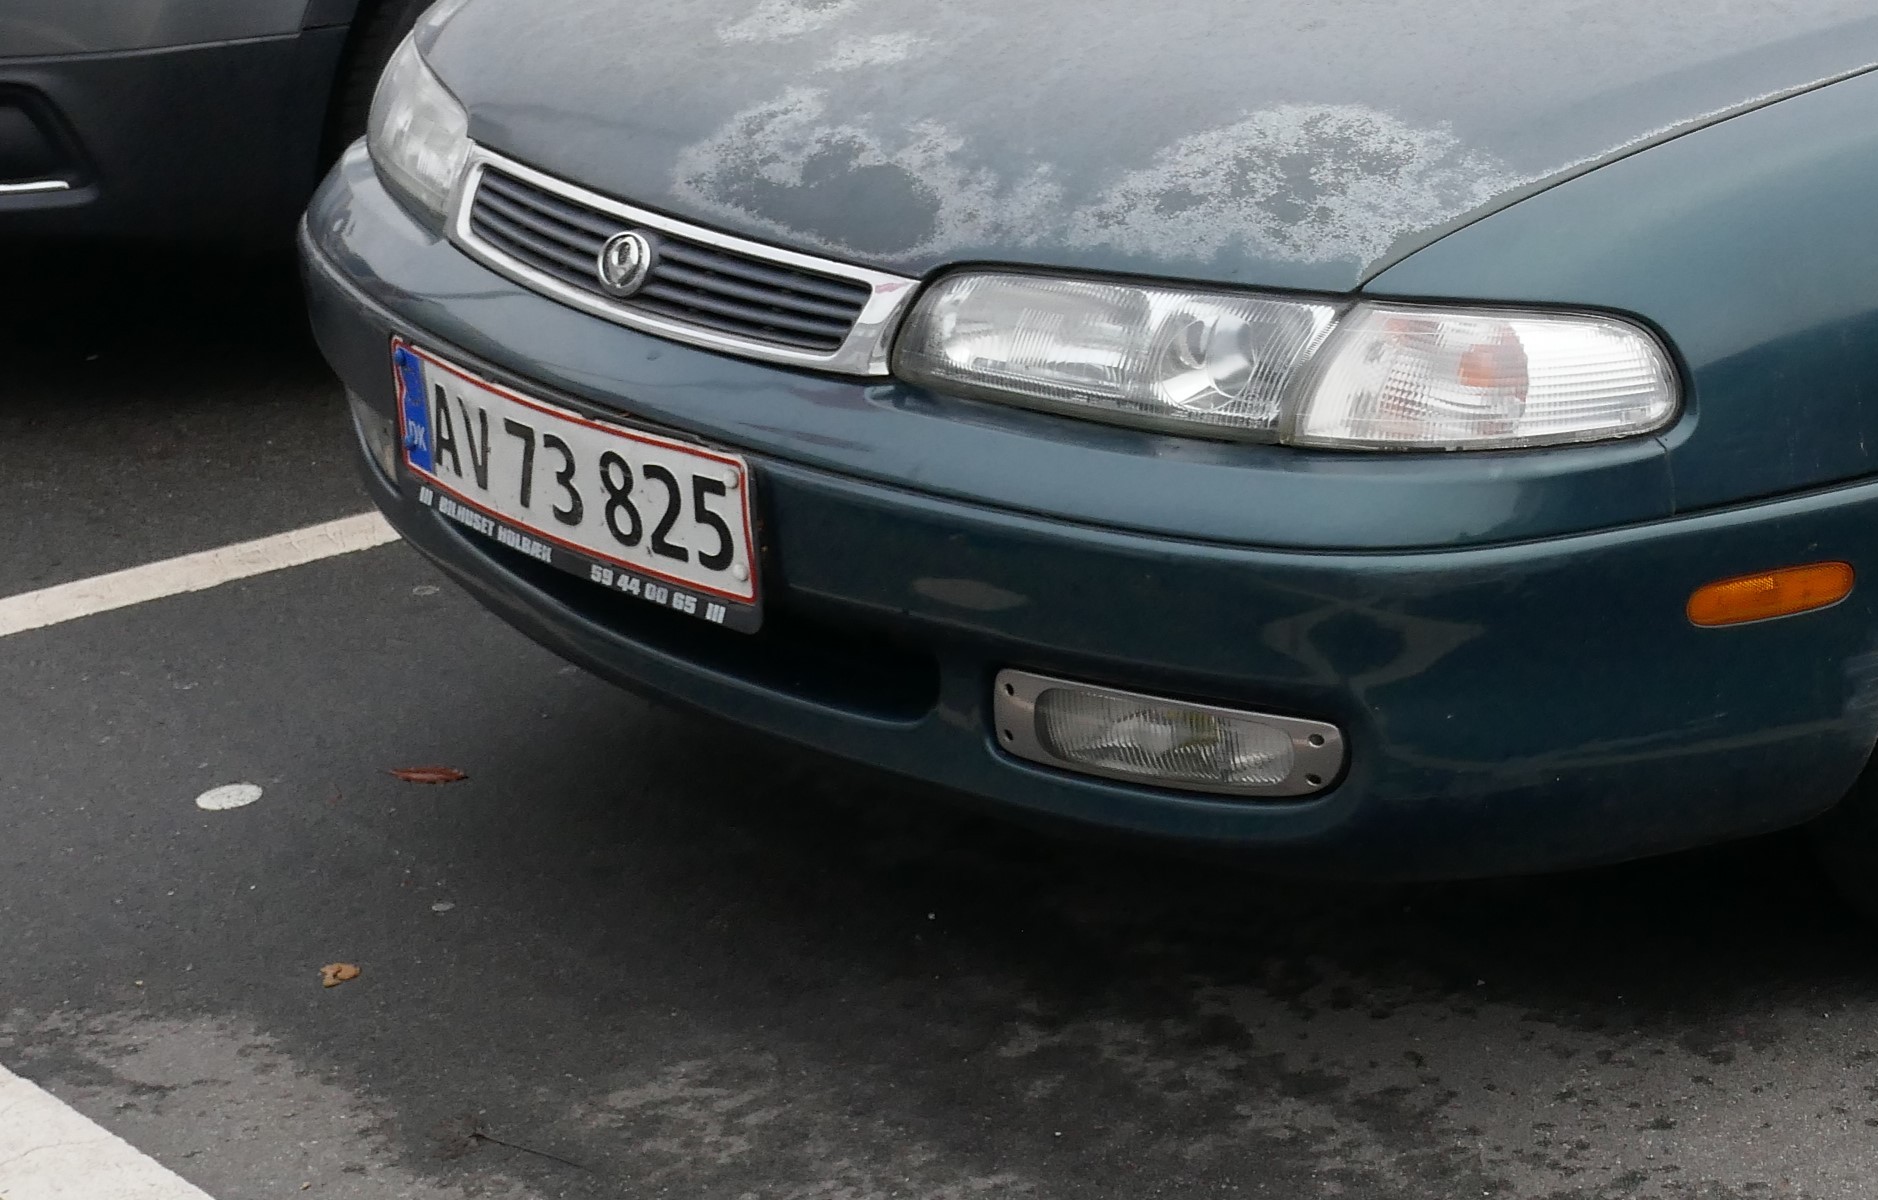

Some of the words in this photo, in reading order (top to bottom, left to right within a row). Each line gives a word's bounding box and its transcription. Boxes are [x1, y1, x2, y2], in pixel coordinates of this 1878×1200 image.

[435, 383, 490, 491] AV
[503, 417, 585, 527] 73
[600, 450, 735, 572] 825
[439, 495, 495, 537] BILHUSET
[497, 524, 552, 563] HOLBÆK
[590, 564, 614, 586] 59
[617, 574, 641, 596] 44
[672, 592, 698, 614] 65
